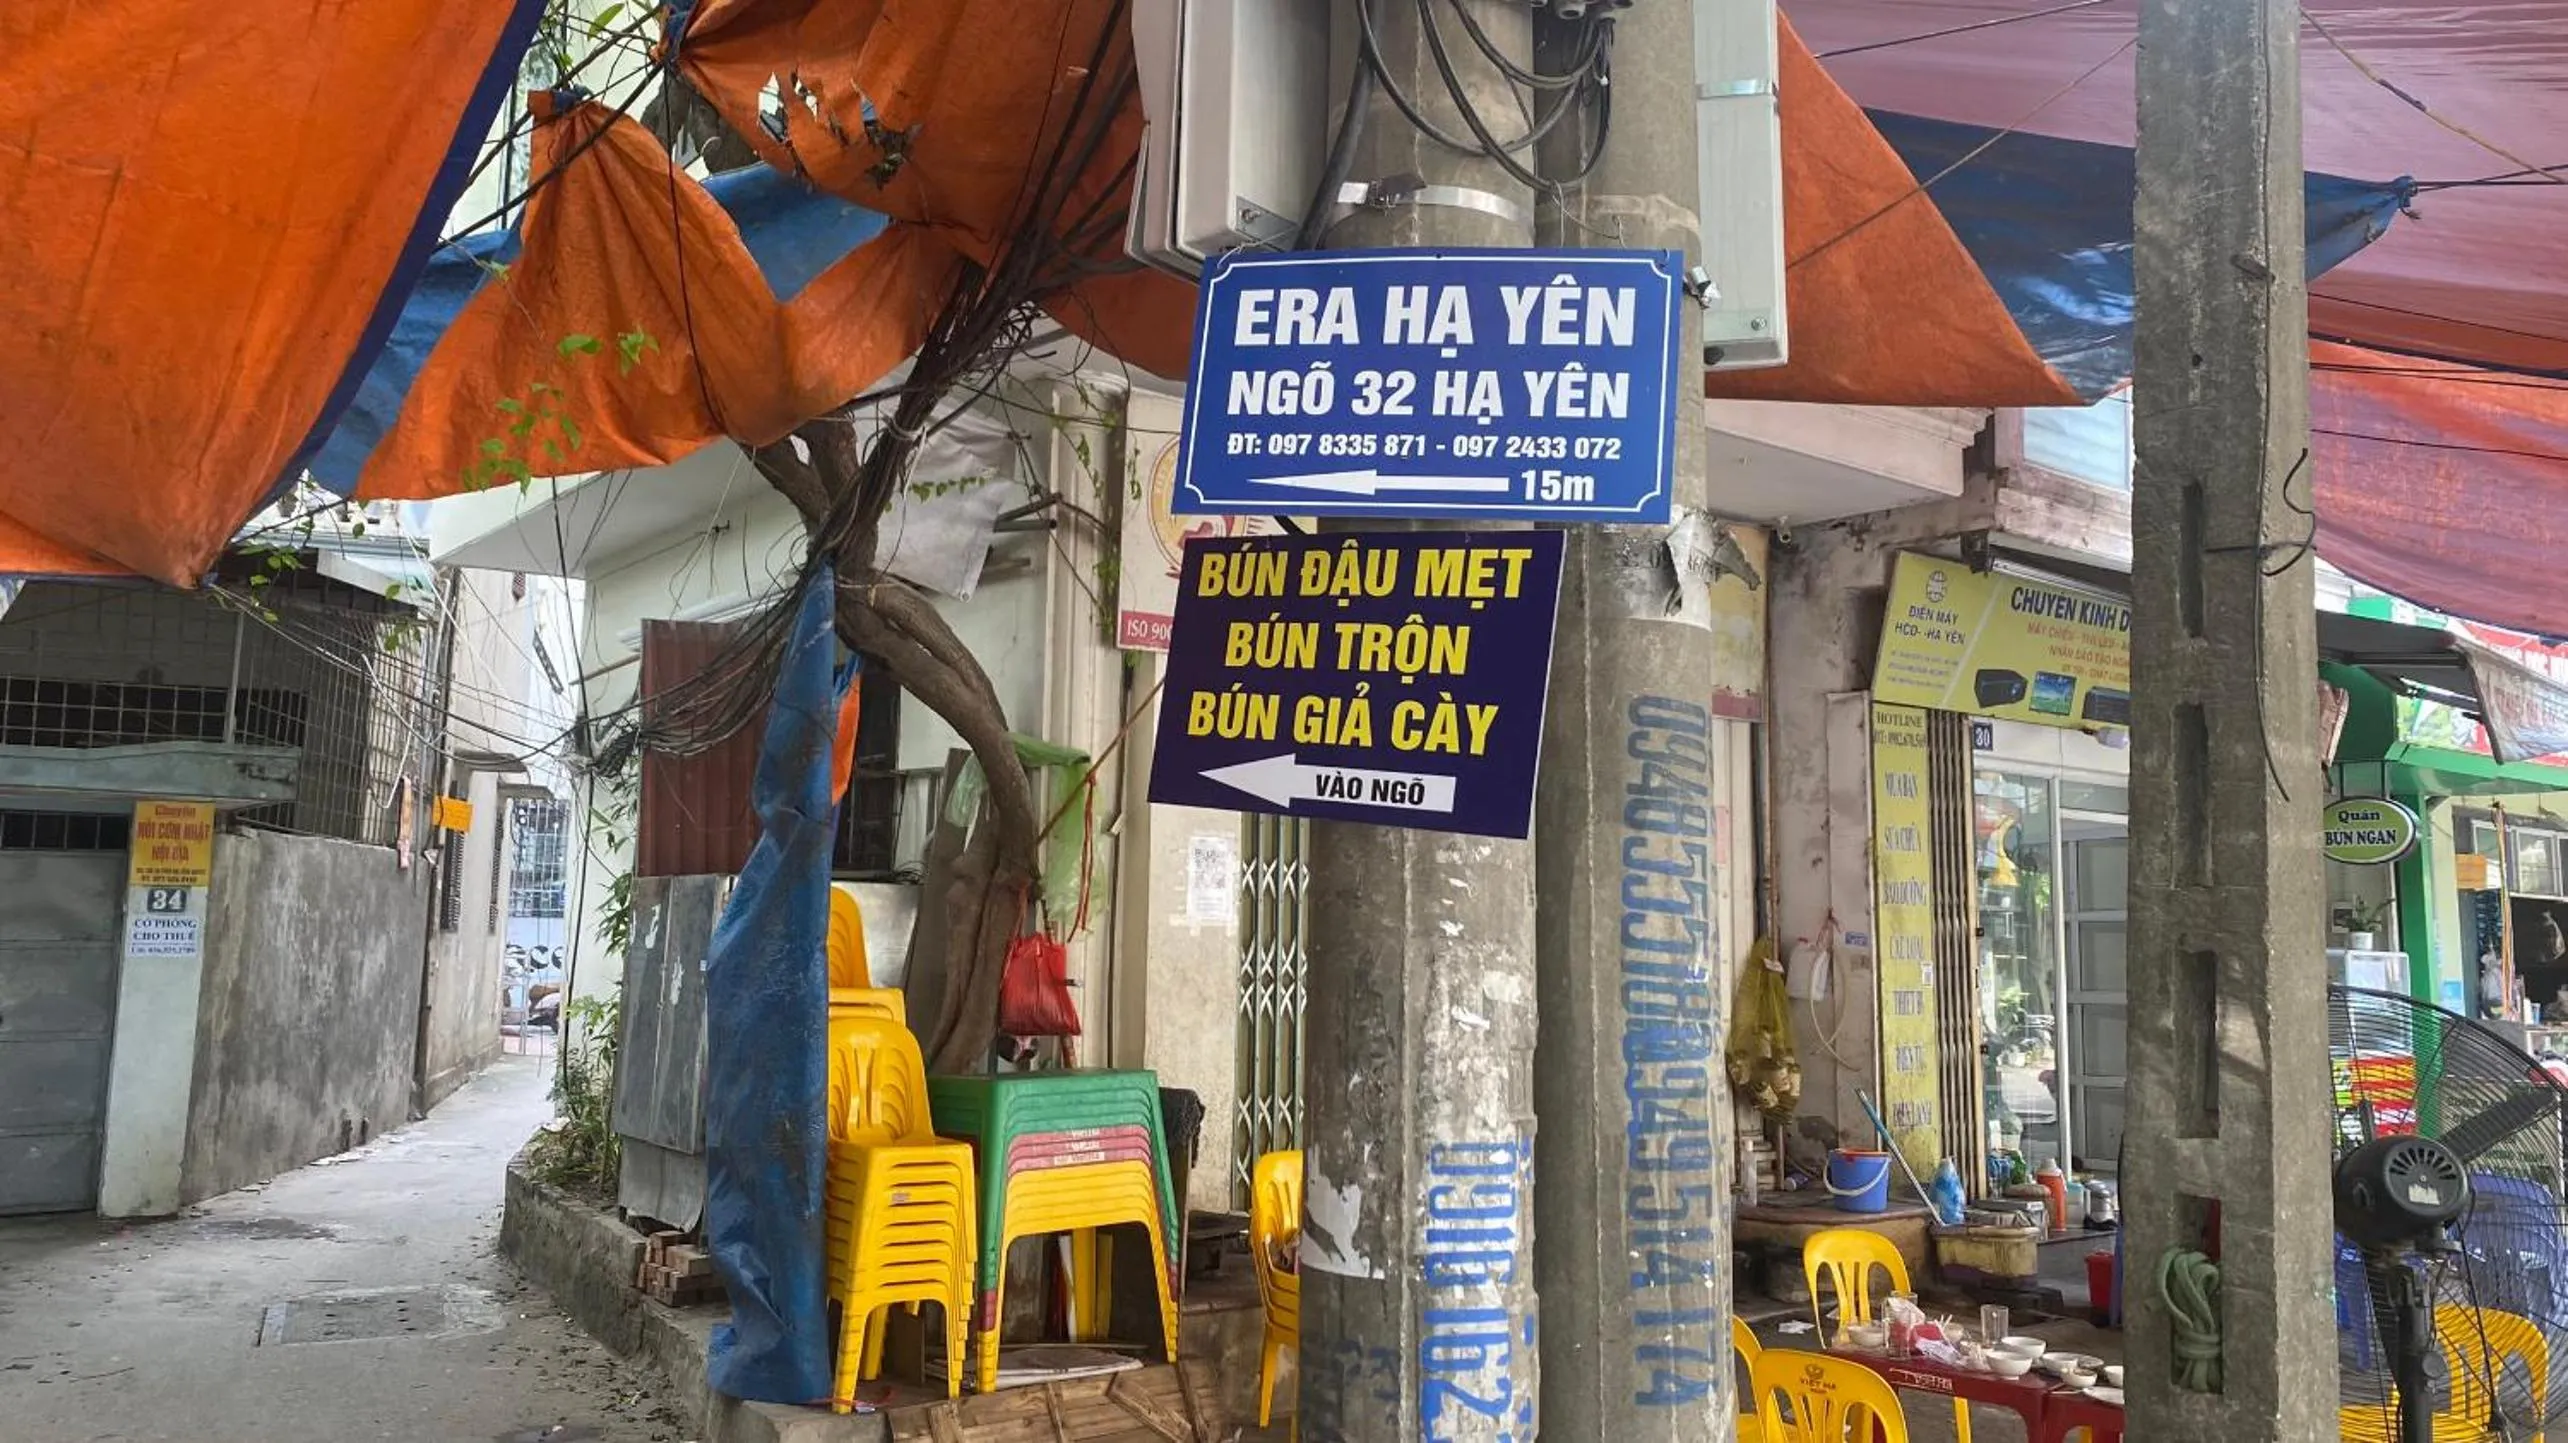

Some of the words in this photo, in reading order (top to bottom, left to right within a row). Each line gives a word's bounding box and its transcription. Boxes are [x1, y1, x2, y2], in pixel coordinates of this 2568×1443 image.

[1234, 287, 1360, 346] ERA
[1383, 285, 1474, 358] HẠ
[1500, 273, 1636, 346] YÊN
[1227, 361, 1335, 415] NGÕ
[1351, 369, 1417, 416] 32
[1432, 371, 1503, 425] HẠ
[1523, 362, 1630, 419] YÊN
[1227, 433, 1261, 455] ĐT:
[1268, 433, 1312, 456] 097
[1319, 434, 1377, 456] 8335
[1385, 435, 1426, 457] 871
[1453, 435, 1498, 457] 097
[1505, 437, 1566, 459] 2433
[1574, 438, 1621, 460] 072
[1521, 470, 1594, 502] 15m
[1198, 543, 1288, 597] BÚN
[1300, 539, 1399, 607] ĐẬU
[1414, 549, 1532, 609] MẸT
[2011, 586, 2077, 622] CHUYÊN
[2078, 601, 2118, 631] KINH
[1127, 619, 1148, 638] ISO
[1225, 612, 1319, 669] BÚN
[1335, 614, 1470, 684] TRỘN
[1187, 682, 1280, 740] BÚN
[1293, 681, 1372, 748] GIẢ
[1391, 691, 1499, 756] CÀY
[1877, 711, 1923, 728] HOTLINE
[1975, 727, 1990, 747] 30
[1315, 771, 1362, 799] VÀO
[1371, 777, 1425, 806] NGÕ
[2325, 828, 2354, 846] BÚN
[2356, 829, 2396, 845] NGAN
[152, 889, 183, 910] 34
[133, 931, 160, 941] CHO
